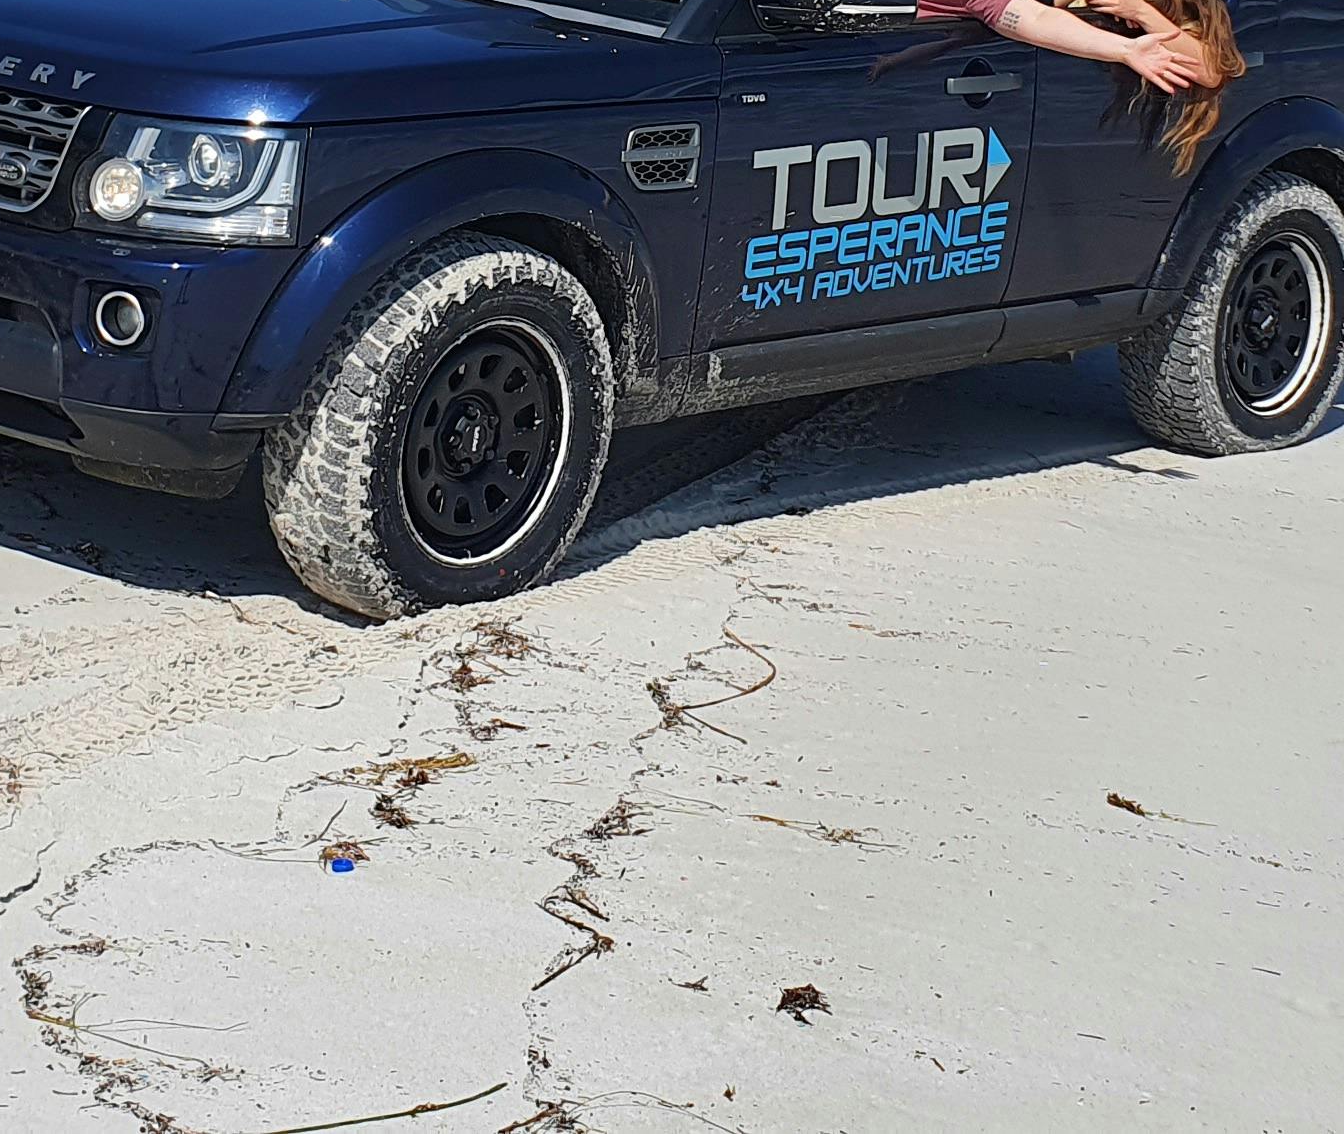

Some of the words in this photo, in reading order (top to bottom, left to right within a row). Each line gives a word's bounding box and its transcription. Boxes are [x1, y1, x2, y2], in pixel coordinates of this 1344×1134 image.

[753, 126, 986, 231] TOUR
[744, 201, 1010, 280] ESPERANCE
[811, 244, 1003, 300] ADVENTURES
